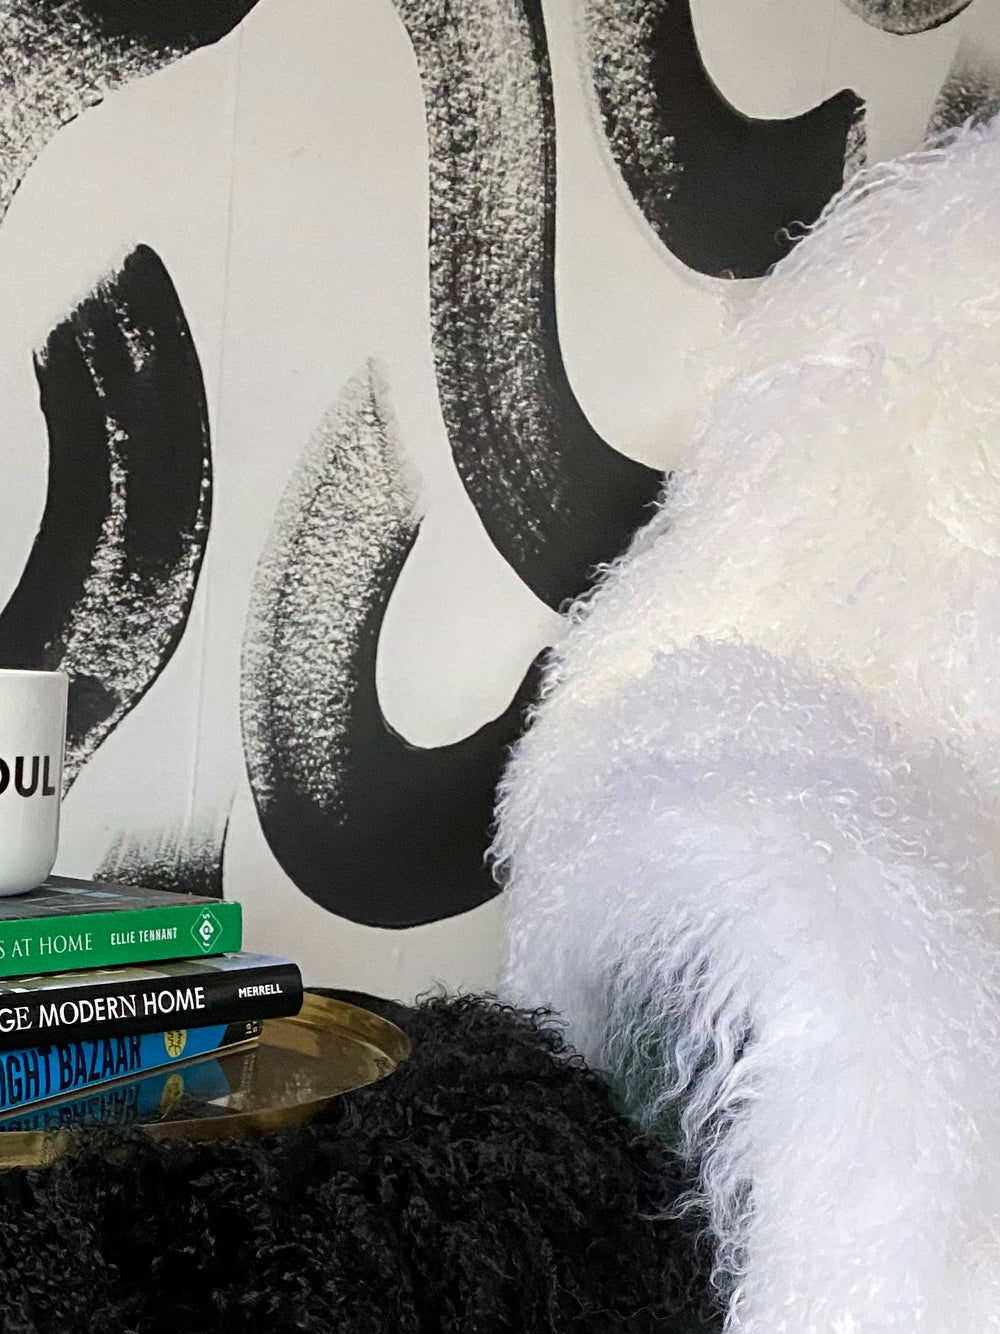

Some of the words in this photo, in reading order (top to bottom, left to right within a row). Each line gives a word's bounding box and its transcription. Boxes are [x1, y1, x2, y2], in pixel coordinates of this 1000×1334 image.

[9, 937, 32, 958] AT
[41, 932, 93, 955] HOME
[110, 930, 136, 946] ELLIE
[138, 926, 178, 943] TENNANT
[237, 983, 283, 999] MERRELL
[38, 993, 137, 1028] MODERN
[142, 986, 206, 1015] HOME
[58, 1035, 142, 1091] BAZAAR
